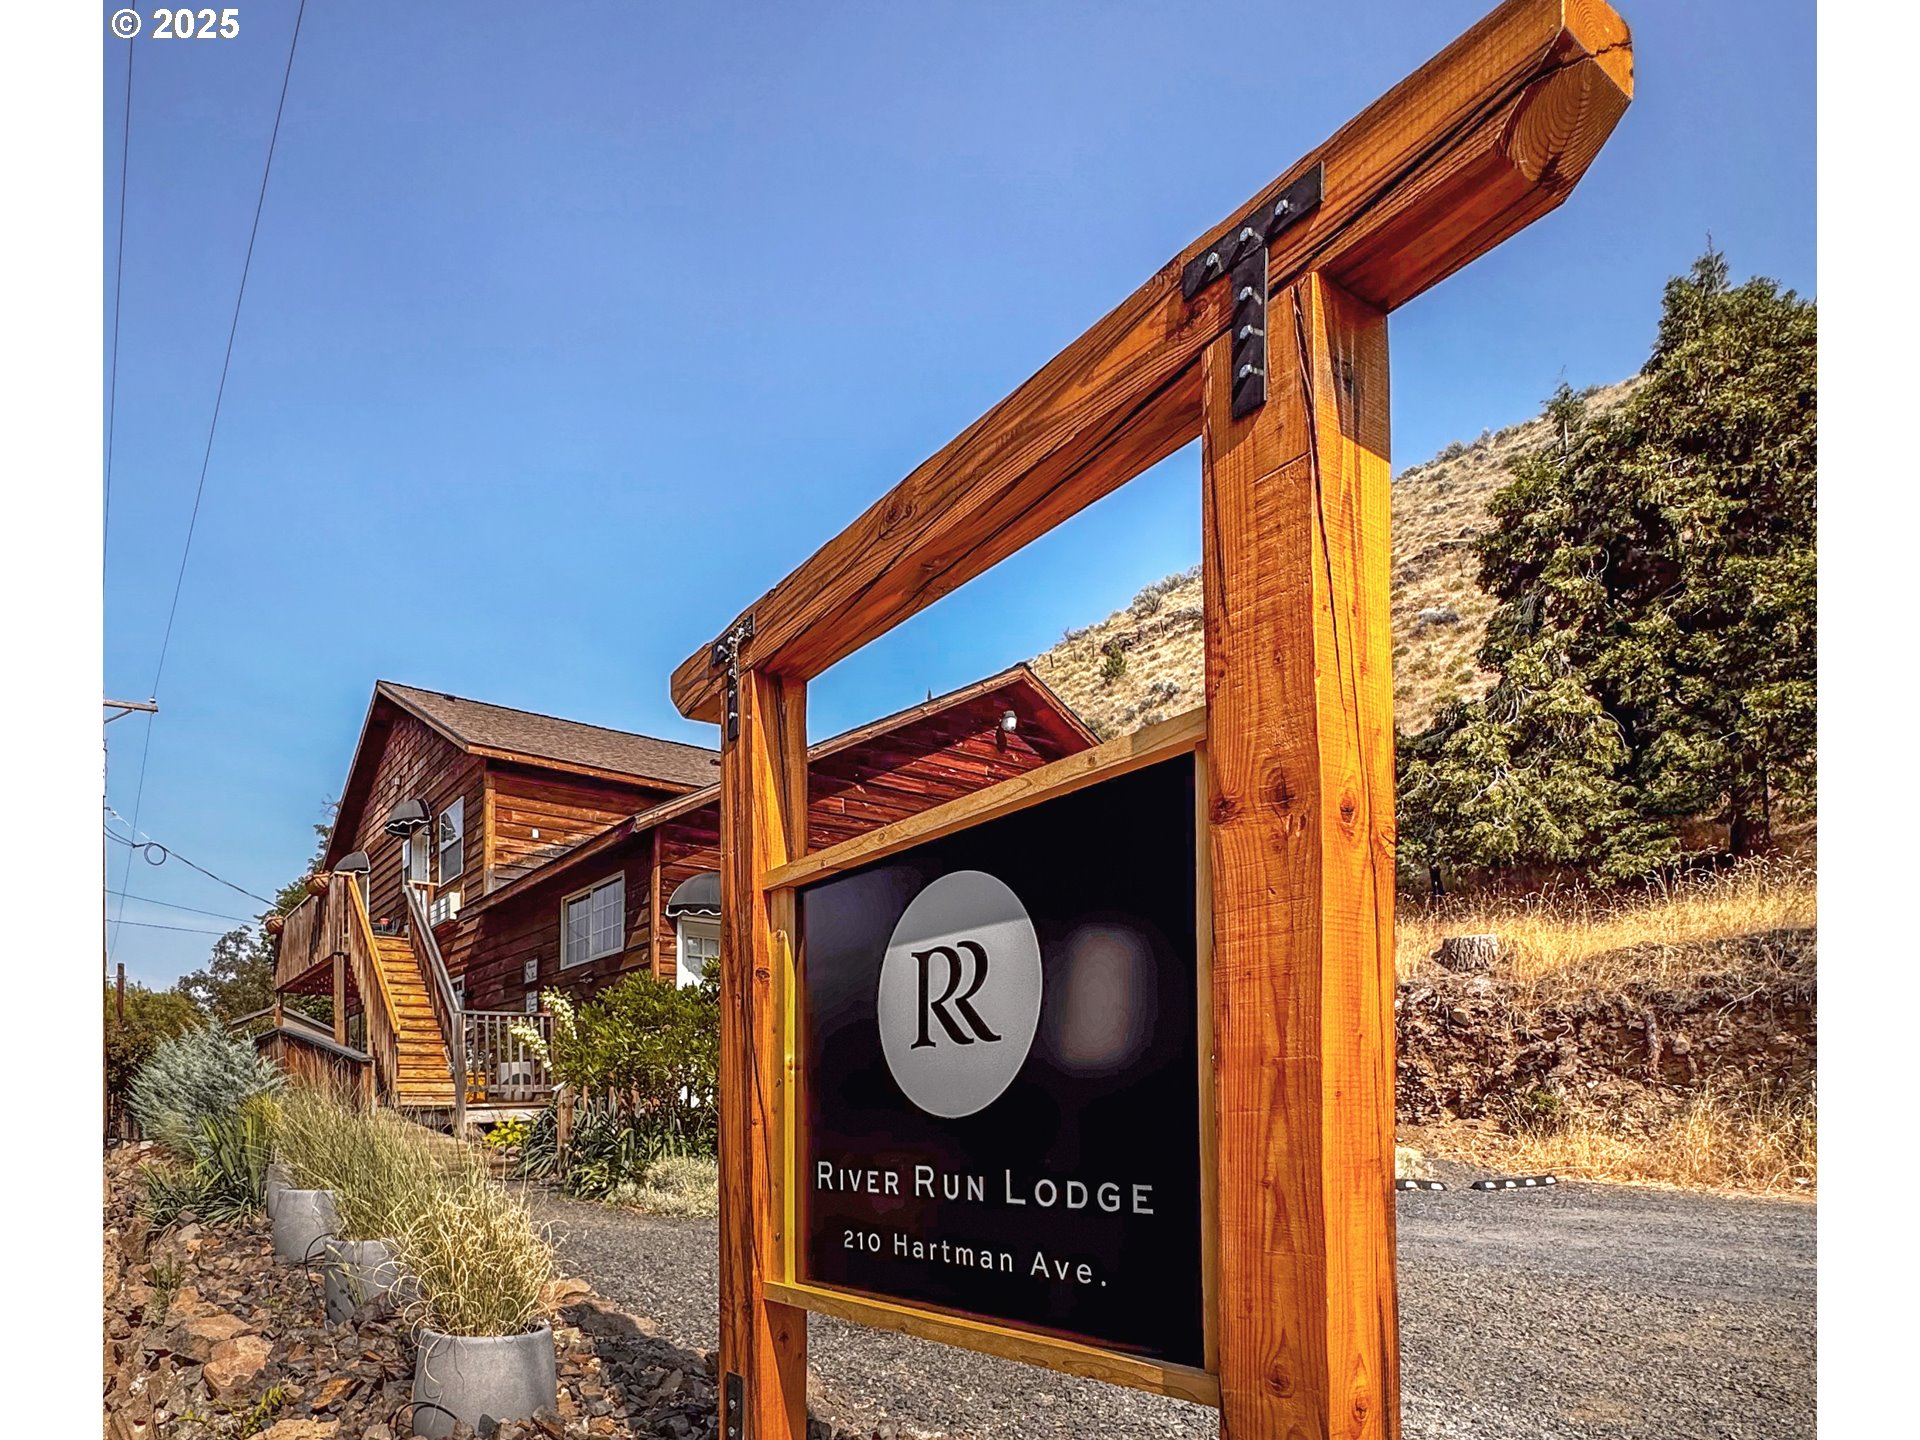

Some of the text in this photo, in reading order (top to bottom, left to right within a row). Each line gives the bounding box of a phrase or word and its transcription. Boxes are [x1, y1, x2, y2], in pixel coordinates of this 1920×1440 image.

[843, 1230, 1107, 1288] 210 Hartman Ave.
